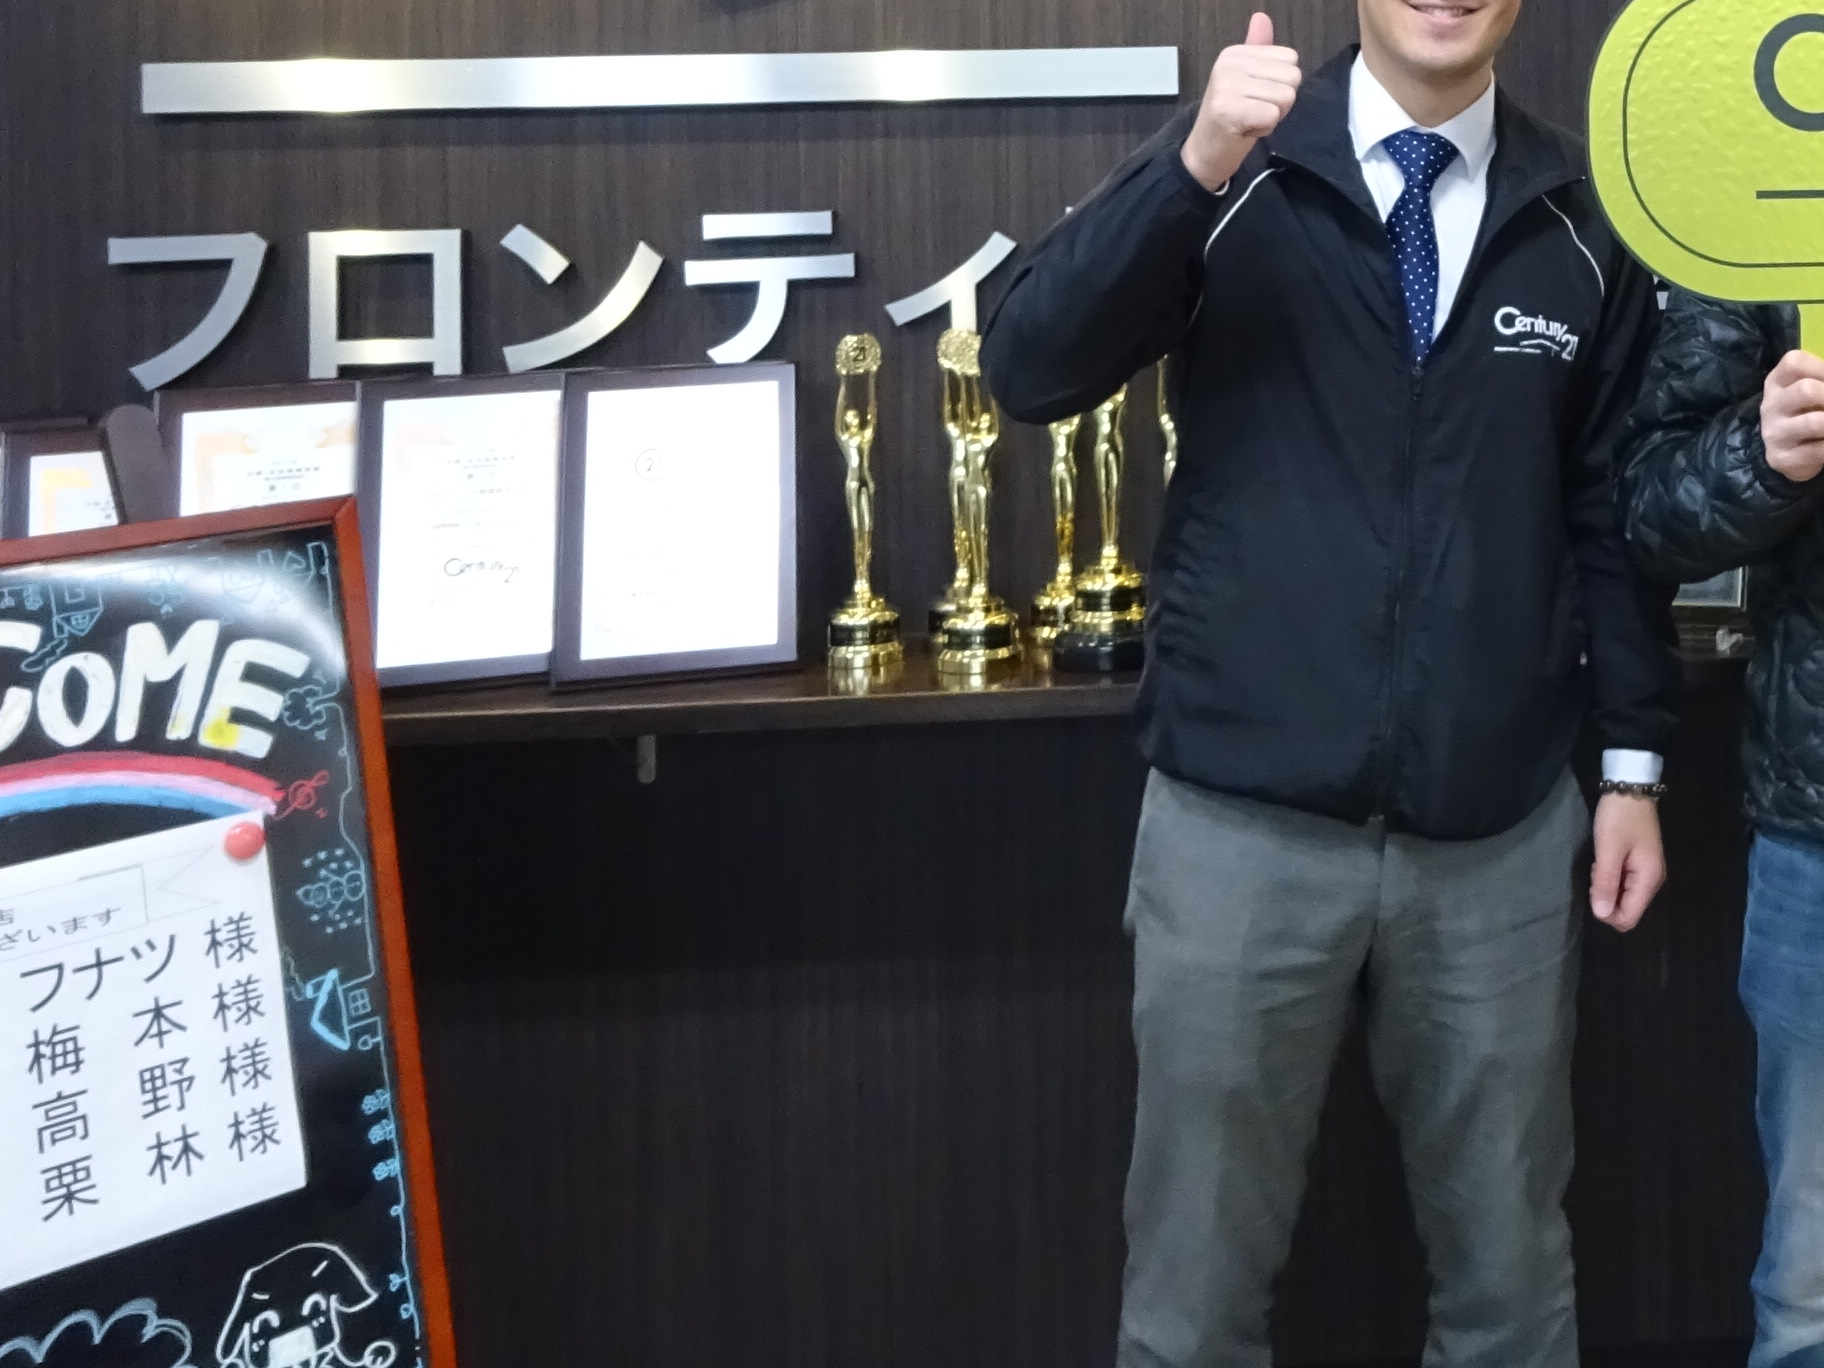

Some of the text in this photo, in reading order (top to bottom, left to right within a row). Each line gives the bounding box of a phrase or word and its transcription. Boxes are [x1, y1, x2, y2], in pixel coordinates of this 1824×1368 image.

[108, 209, 1018, 391] フロンティ
[1494, 306, 1579, 361] Century 21
[20, 911, 259, 1012] フナツ 様
[211, 973, 267, 1032] 様
[219, 1037, 273, 1097] 様
[227, 1101, 282, 1162] 様
